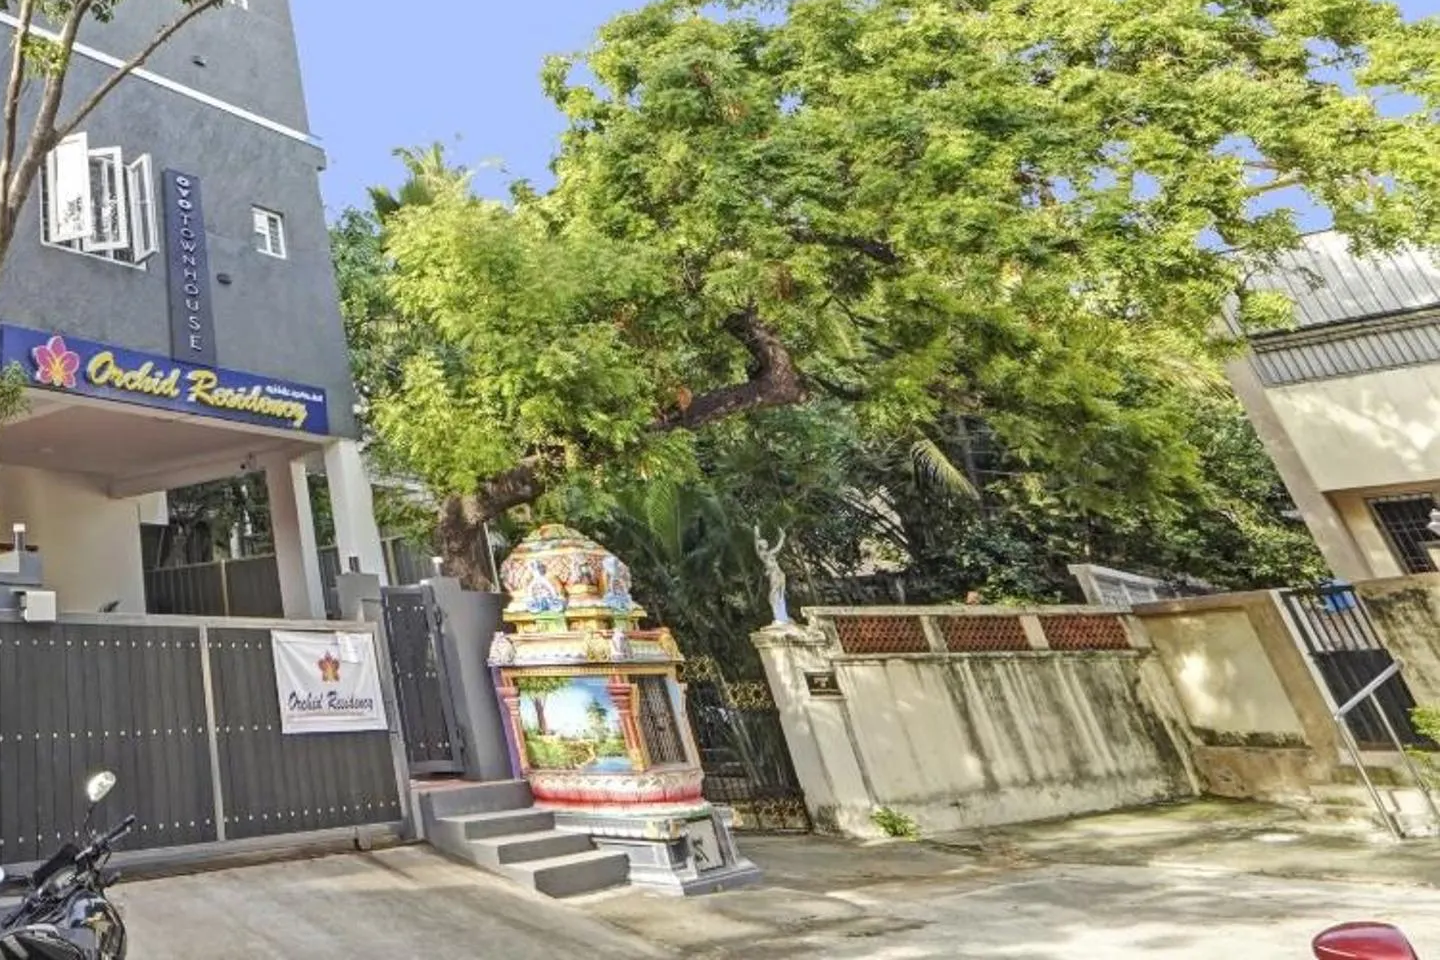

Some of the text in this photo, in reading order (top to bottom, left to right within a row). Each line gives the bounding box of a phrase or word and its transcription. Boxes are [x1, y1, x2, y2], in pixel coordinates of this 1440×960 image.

[86, 351, 308, 428] Orchid Residency
[288, 690, 374, 711] Orchid Residency
